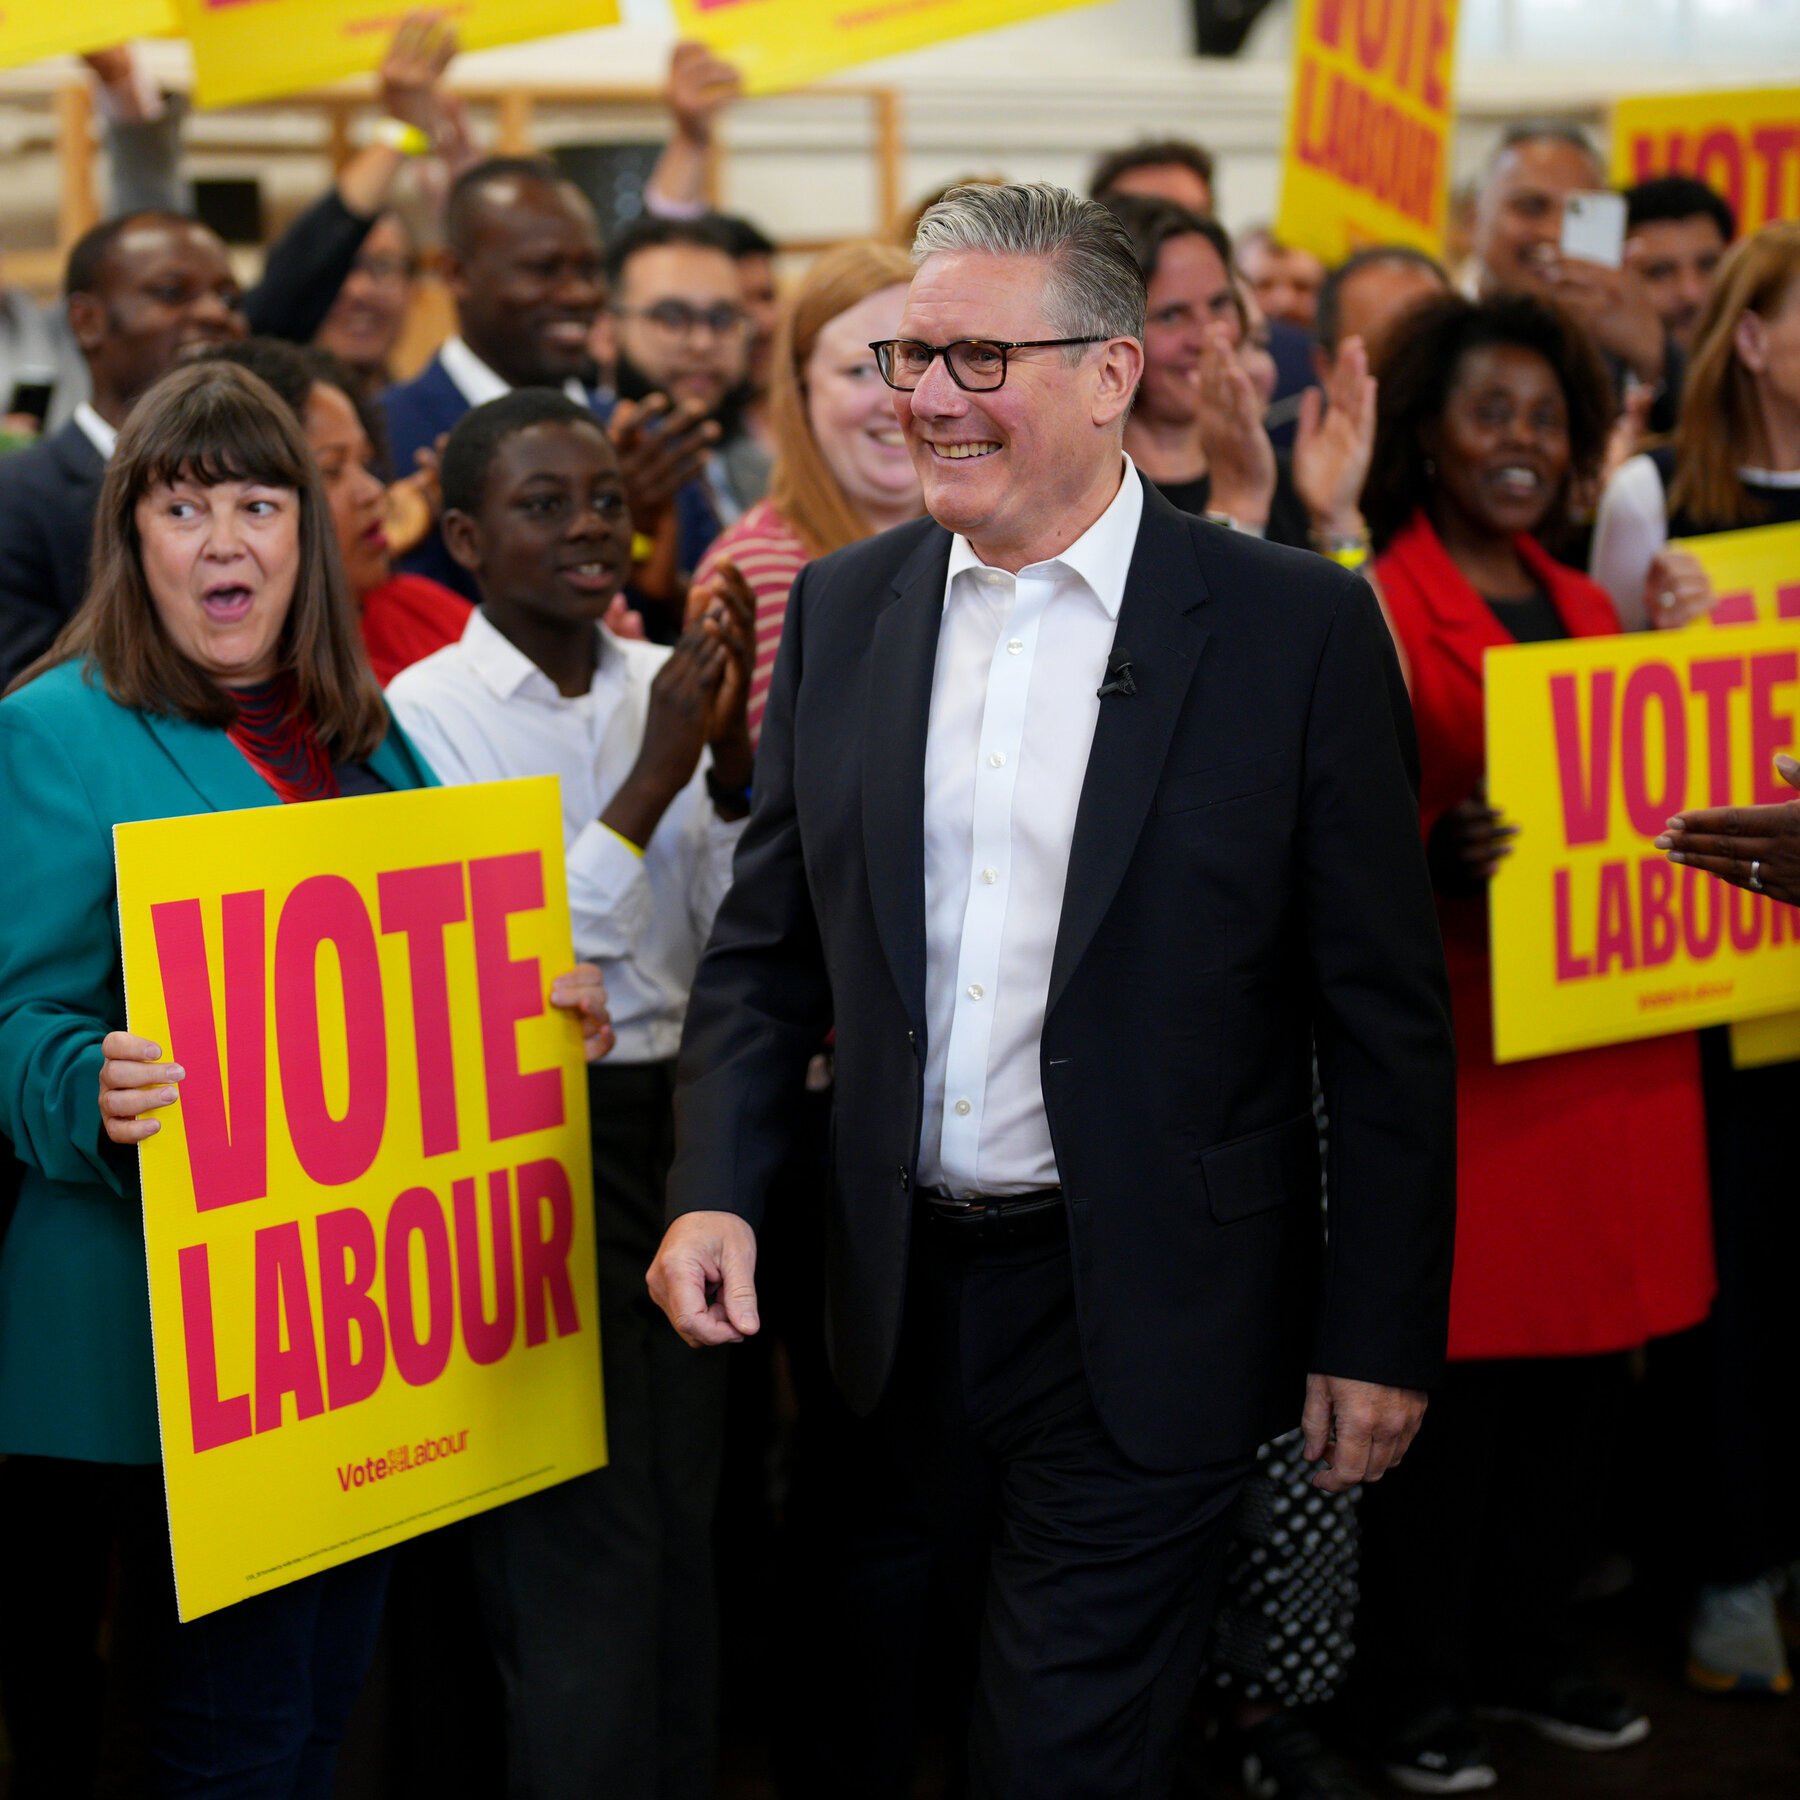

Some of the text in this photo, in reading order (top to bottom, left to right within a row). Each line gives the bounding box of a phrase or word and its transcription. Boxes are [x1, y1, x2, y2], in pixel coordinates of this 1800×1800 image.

[1549, 650, 1800, 848] VOTE
[151, 851, 566, 1212] VOTE
[178, 1158, 581, 1453] LABOUR
[337, 1429, 470, 1493] Vote Labour
